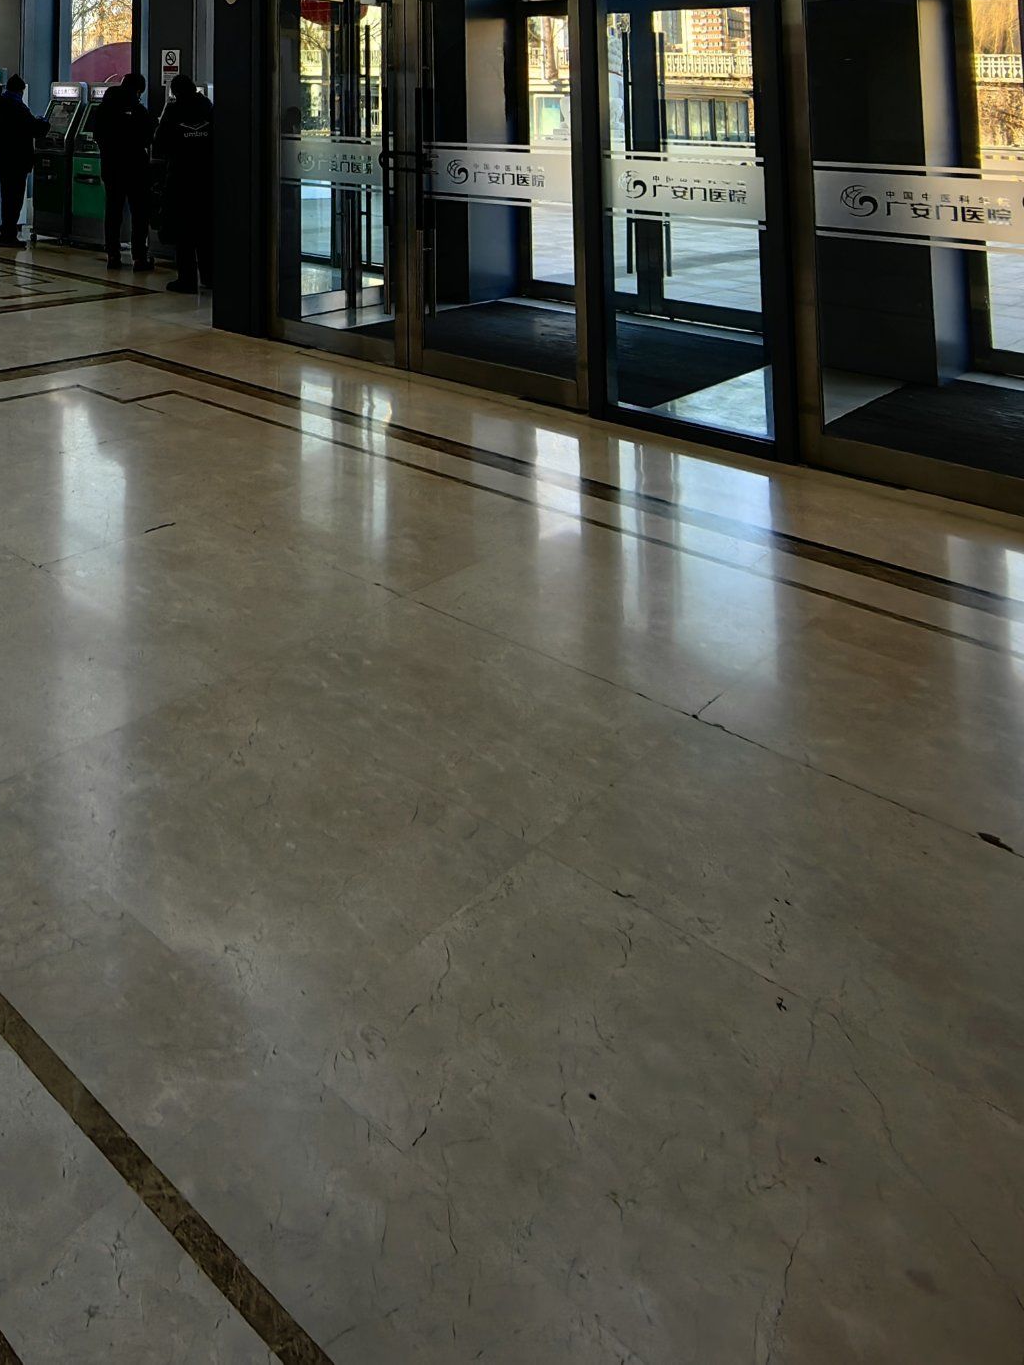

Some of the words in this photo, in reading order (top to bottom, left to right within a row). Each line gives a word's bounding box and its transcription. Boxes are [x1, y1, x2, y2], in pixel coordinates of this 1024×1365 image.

[473, 171, 546, 188] 广安门医院
[652, 184, 748, 205] 广安门医院
[885, 201, 1013, 226] 广安门医院
